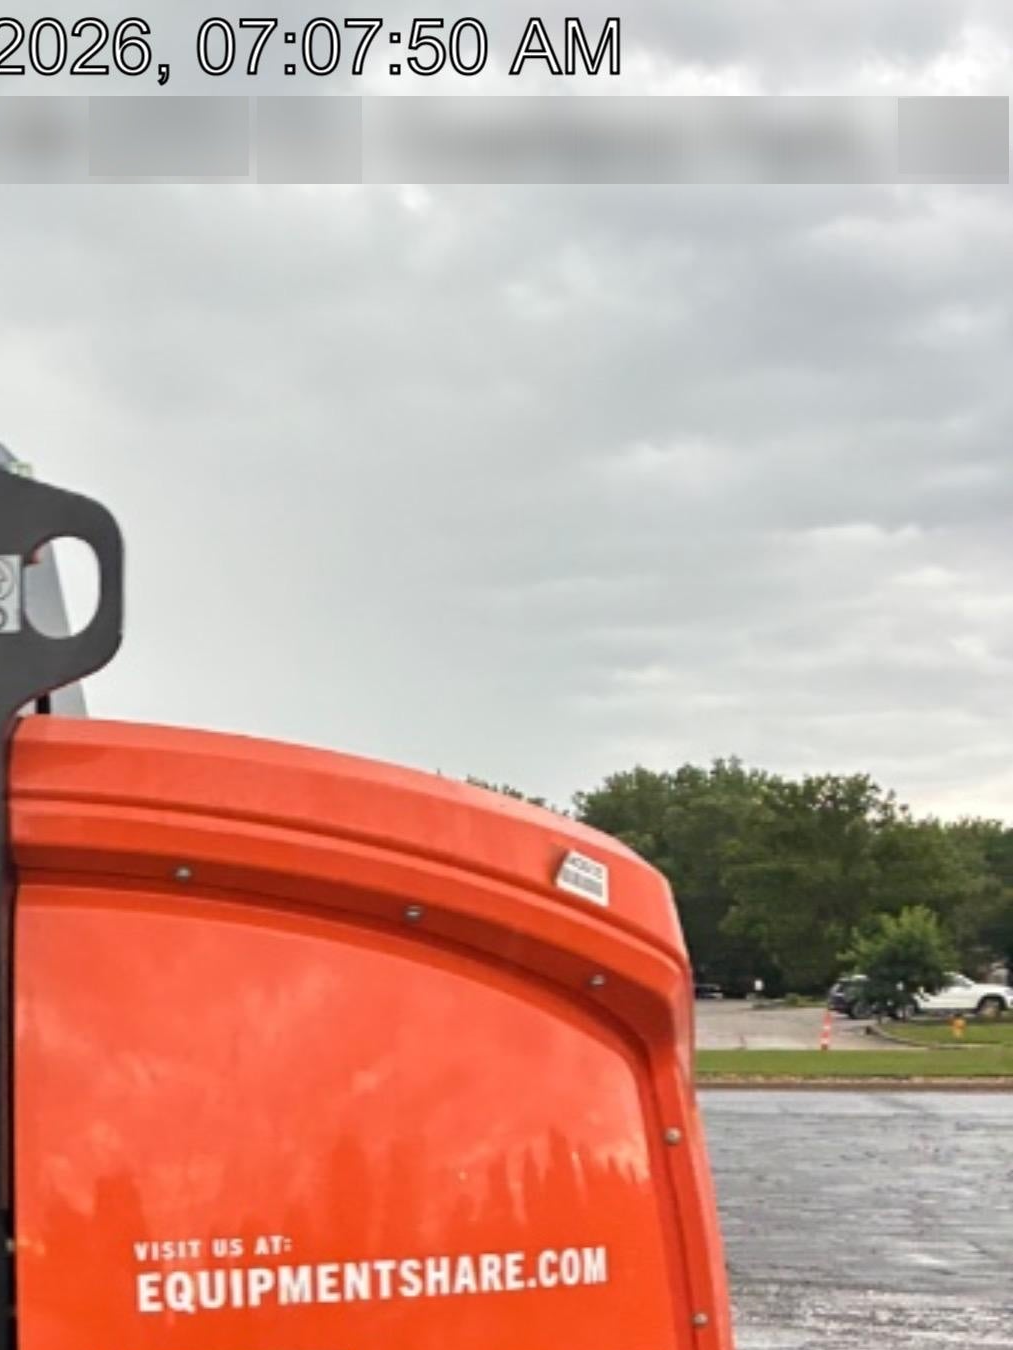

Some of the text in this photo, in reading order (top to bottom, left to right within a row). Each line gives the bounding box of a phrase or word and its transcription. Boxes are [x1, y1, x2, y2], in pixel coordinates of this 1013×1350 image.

[134, 1235, 292, 1262] VISIT US AT:
[137, 1247, 607, 1313] EQUIPMENTSHARE.COM
